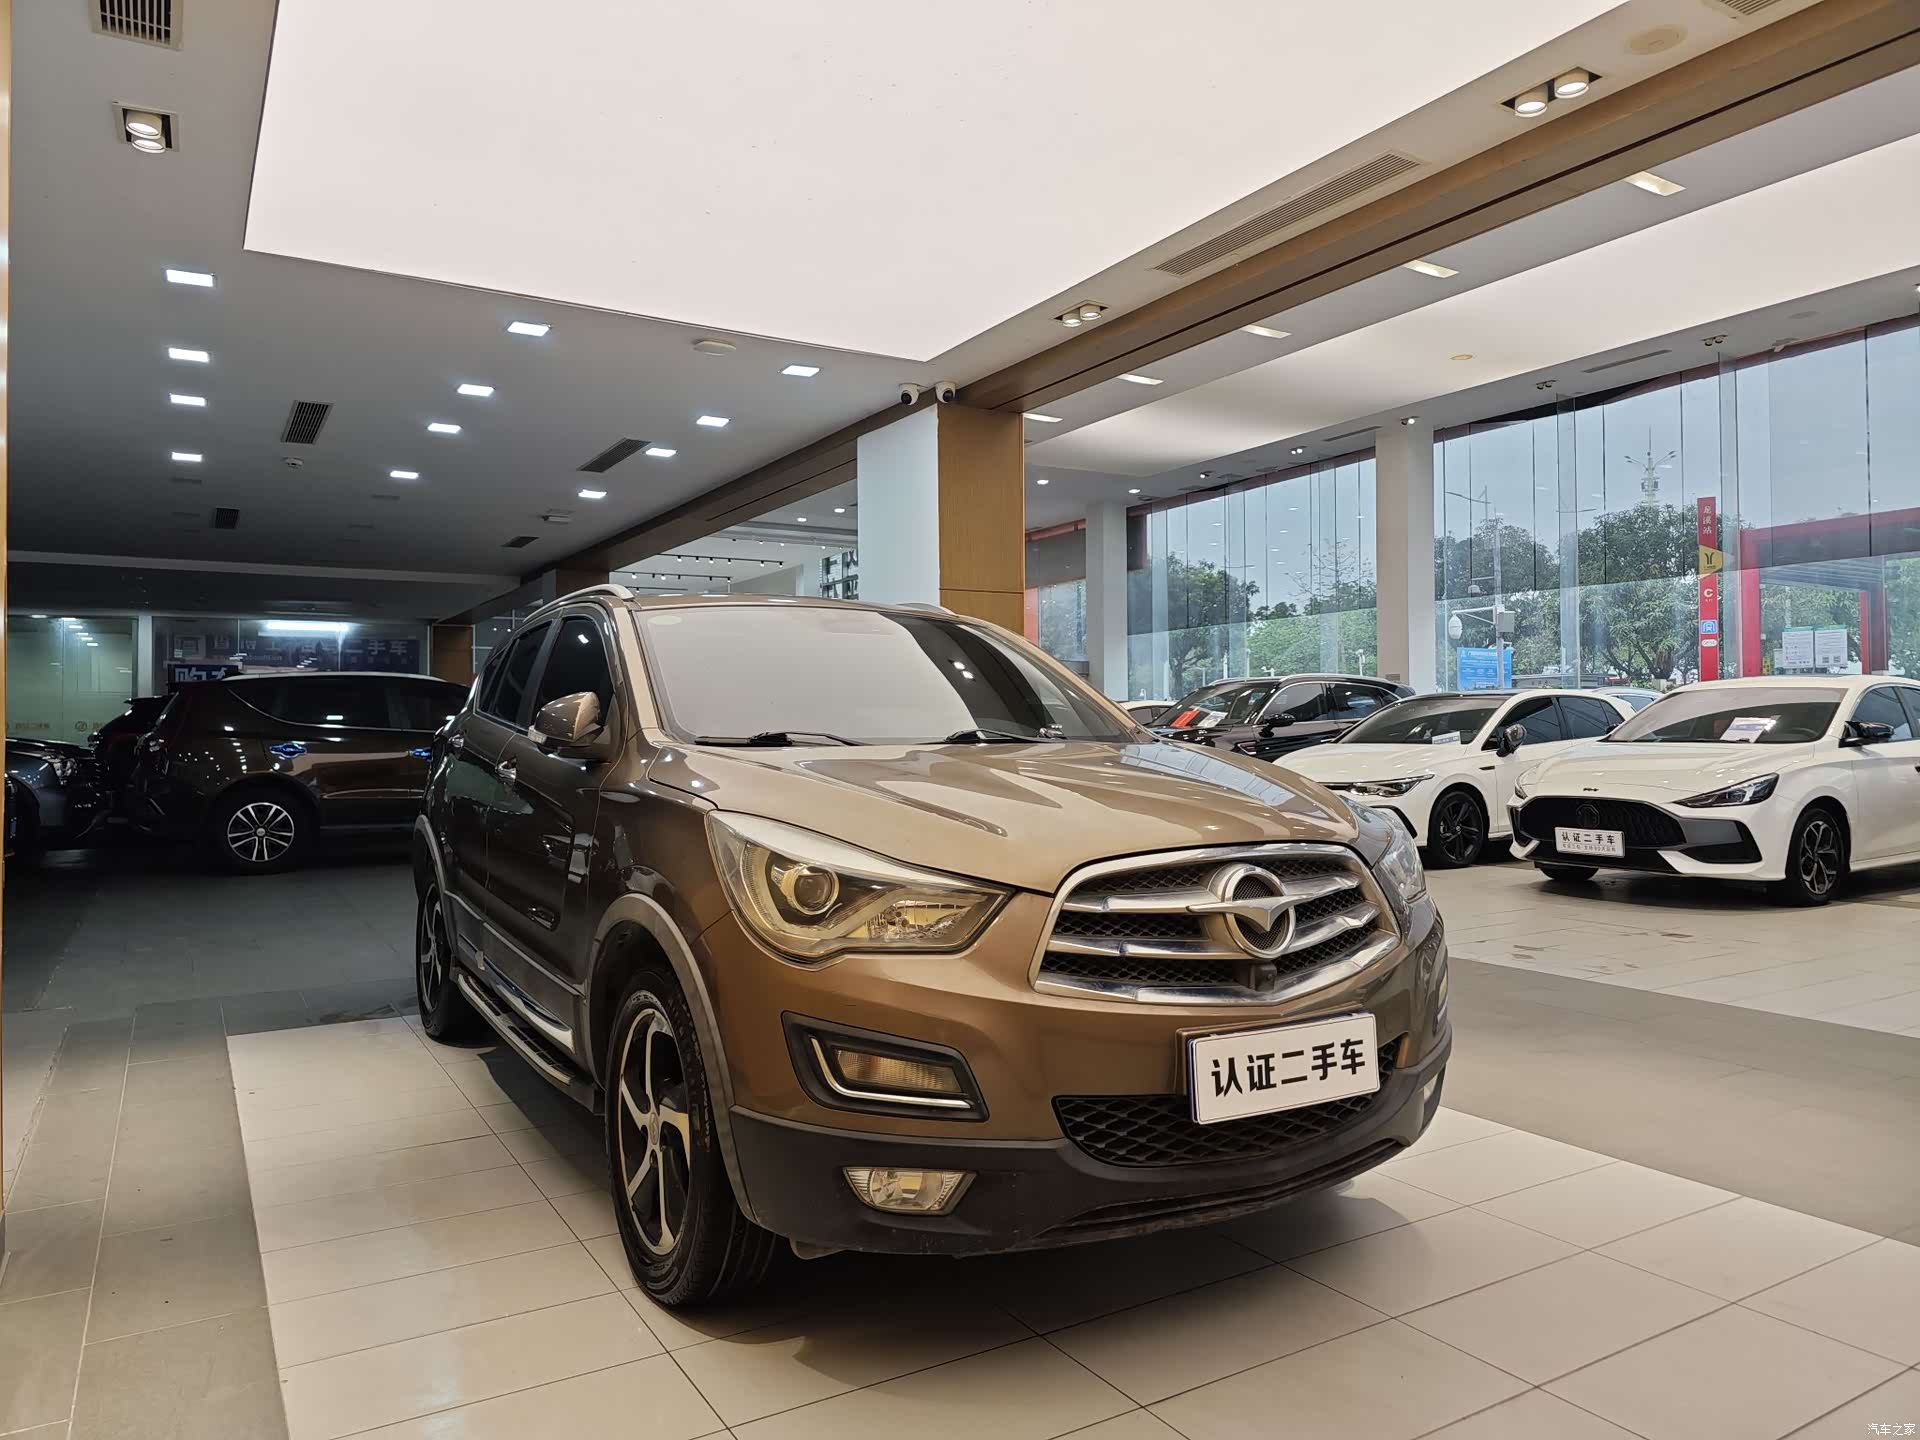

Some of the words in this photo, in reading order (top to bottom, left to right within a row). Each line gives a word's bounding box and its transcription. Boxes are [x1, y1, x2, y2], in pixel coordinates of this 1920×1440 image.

[1703, 588, 1714, 598] C
[1562, 832, 1616, 845] 认证二手车
[1211, 1038, 1366, 1097] 认证二手车
